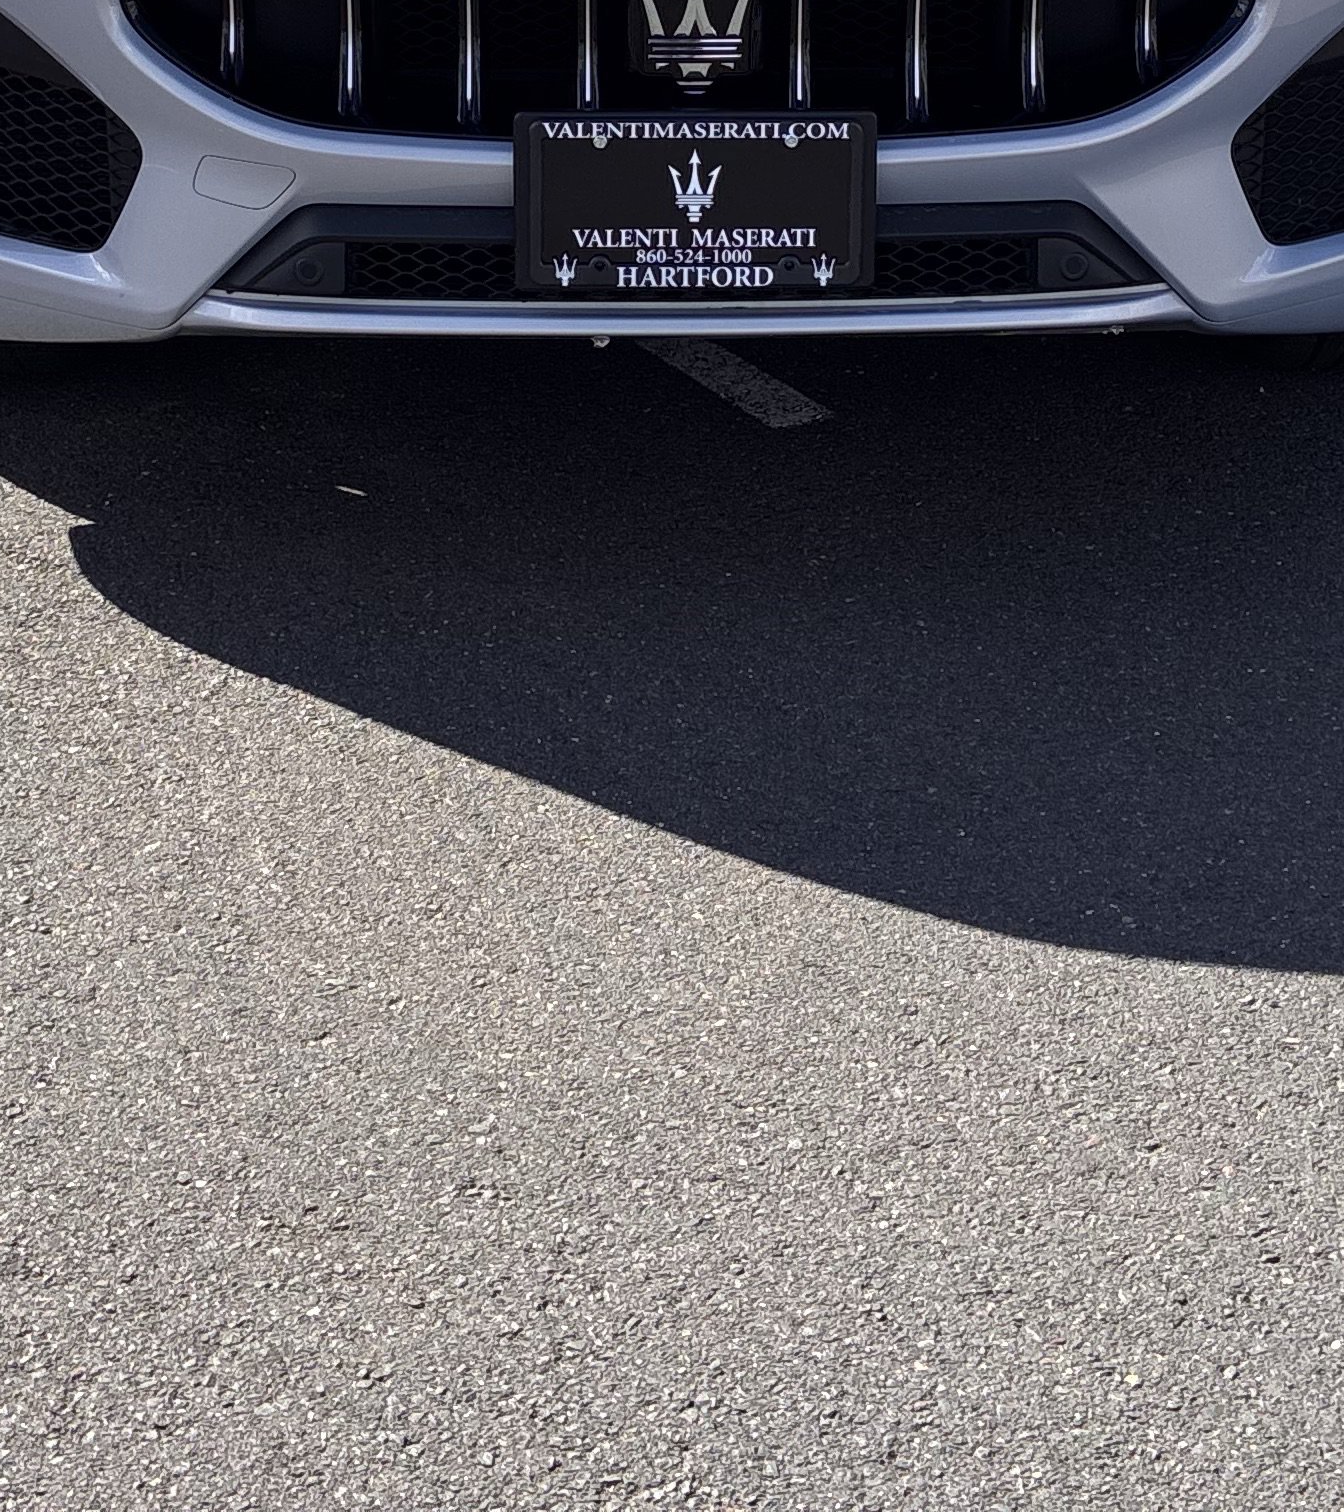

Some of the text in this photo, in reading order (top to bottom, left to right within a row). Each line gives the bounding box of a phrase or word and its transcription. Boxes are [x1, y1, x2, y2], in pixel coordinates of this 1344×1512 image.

[541, 121, 850, 140] VALENTIMASERATI.COM
[572, 228, 817, 248] VALENTI MASERATI
[635, 248, 753, 265] 860-524-1000
[616, 265, 775, 288] HARTFORD
